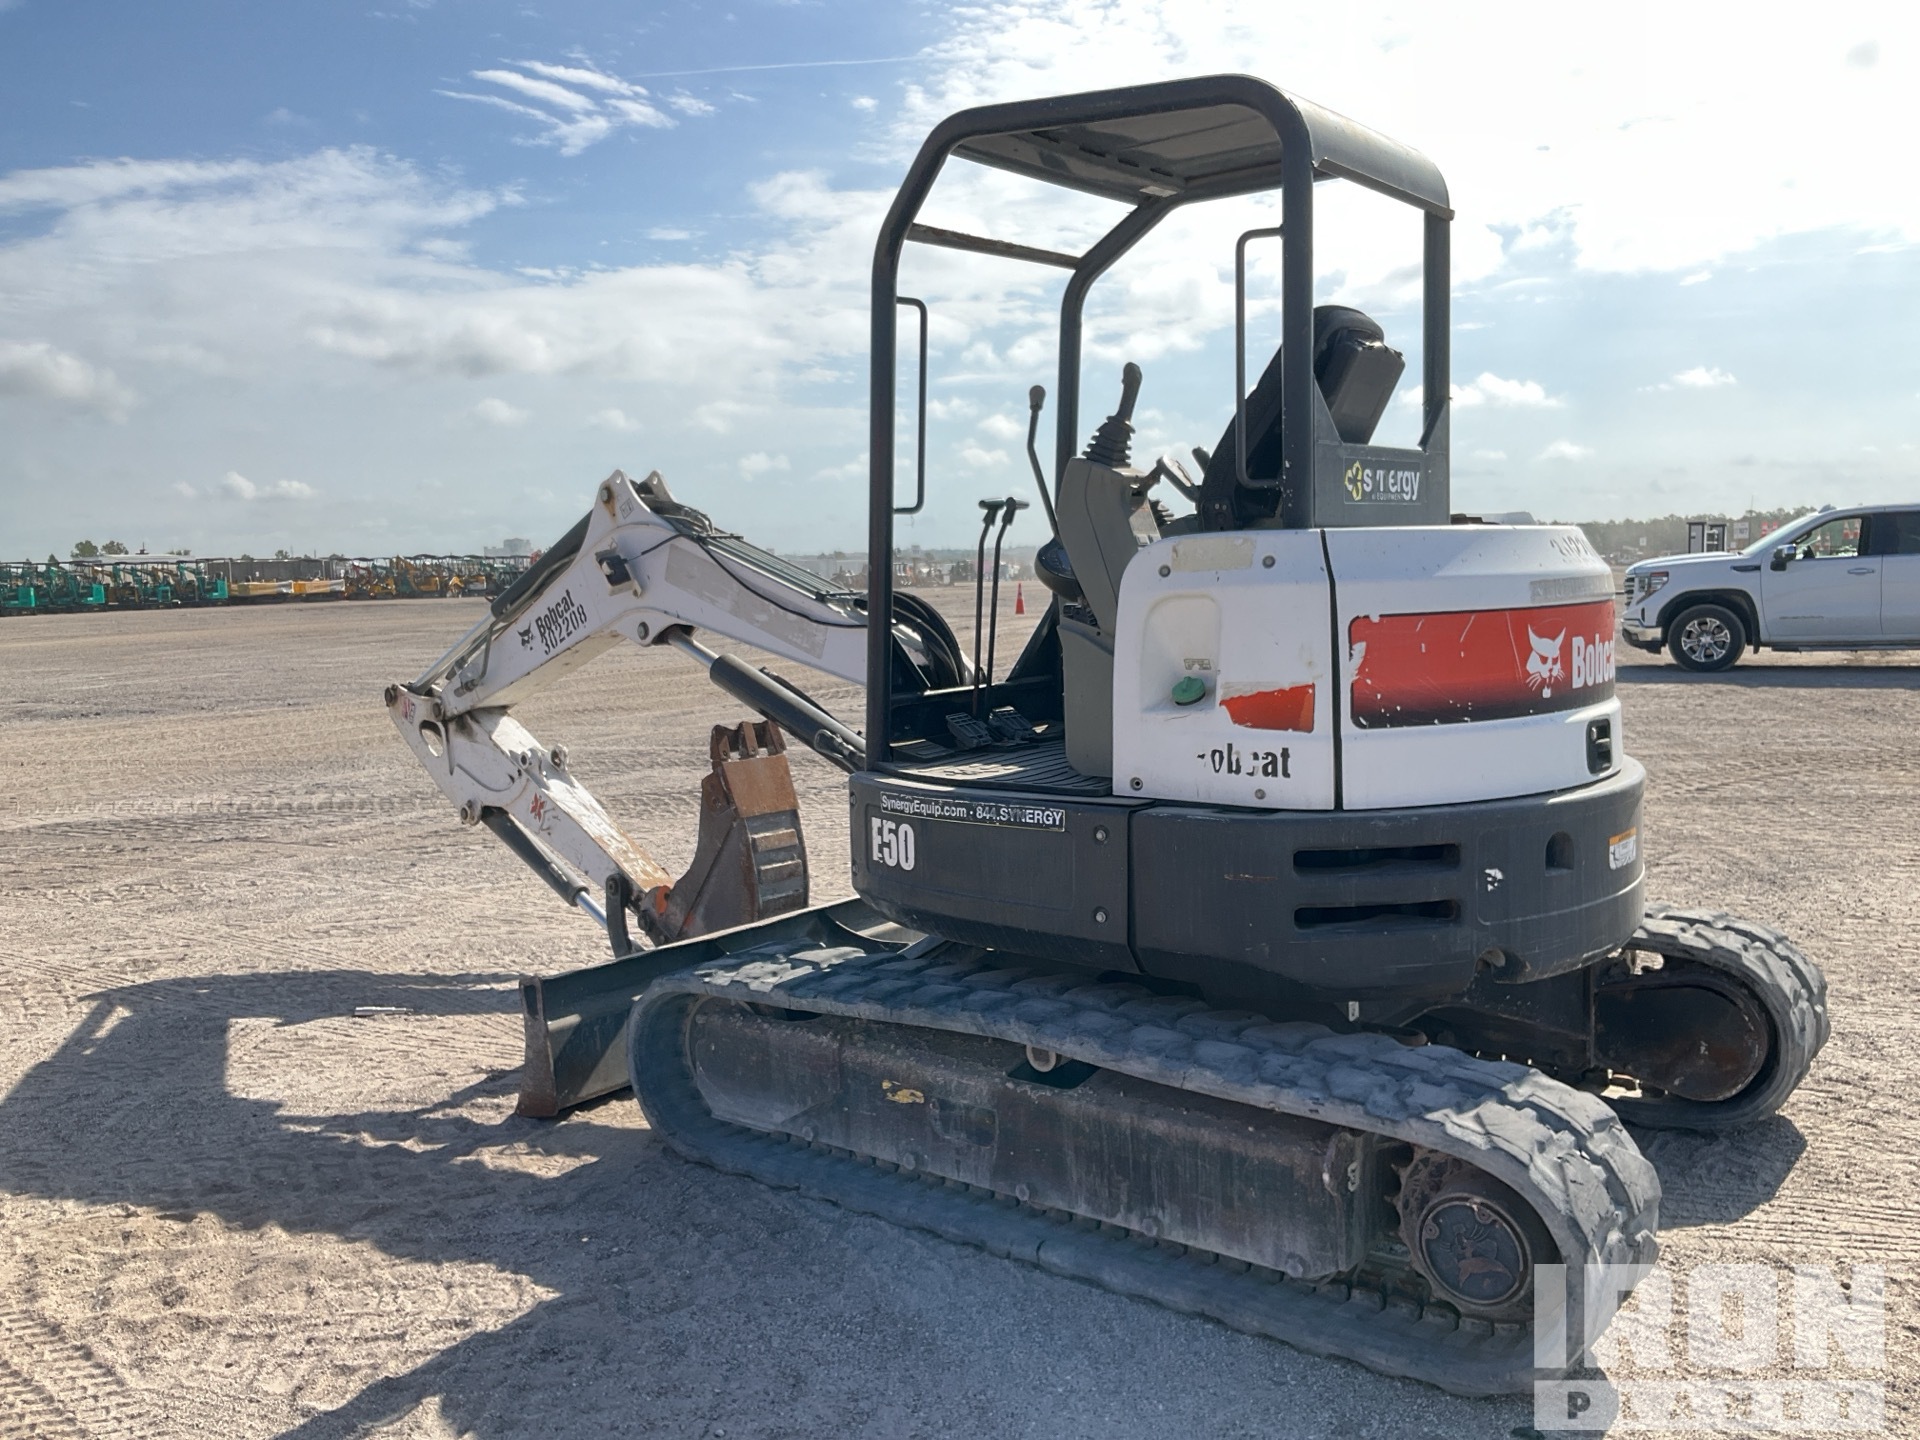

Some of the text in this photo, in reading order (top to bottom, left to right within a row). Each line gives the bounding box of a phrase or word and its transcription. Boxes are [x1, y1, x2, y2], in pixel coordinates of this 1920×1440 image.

[535, 588, 575, 643] Bobcat
[1197, 743, 1291, 778] obcat
[881, 795, 1062, 825] SynergyEquip.com 844.SYNERGY
[871, 816, 915, 871] E50
